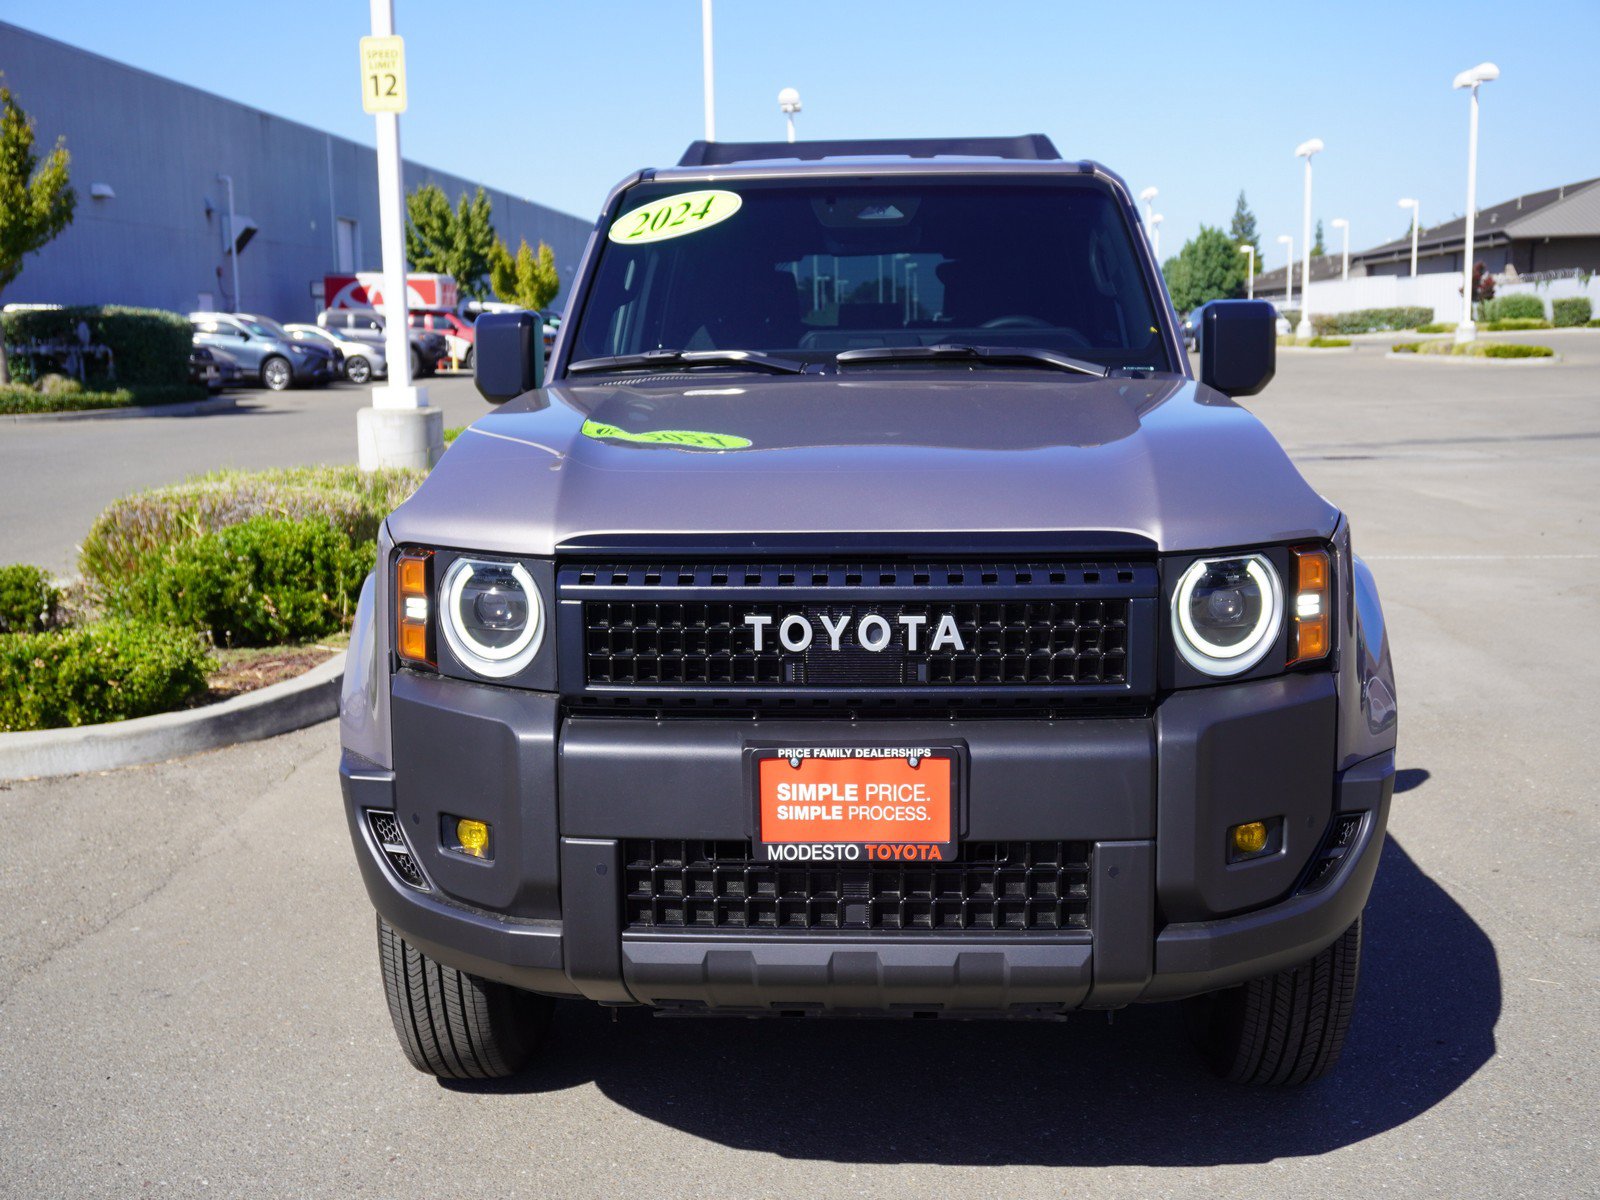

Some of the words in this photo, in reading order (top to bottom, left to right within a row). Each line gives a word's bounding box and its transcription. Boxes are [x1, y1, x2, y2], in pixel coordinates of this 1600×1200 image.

[367, 49, 398, 59] SPEED
[369, 60, 396, 70] LIMIT
[370, 73, 398, 97] 12
[627, 195, 715, 238] 2024
[744, 614, 965, 652] TOYOTA
[778, 749, 811, 758] PRICE
[813, 749, 852, 758] FAMILY
[855, 748, 931, 758] DEALERSHIPS
[776, 783, 858, 802] SIMPLE
[865, 783, 931, 802] PRICE.
[776, 805, 843, 820] SIMPLE
[848, 805, 931, 821] PROCESS.
[767, 844, 860, 861] MODESTO
[864, 845, 942, 860] TOYOTA
